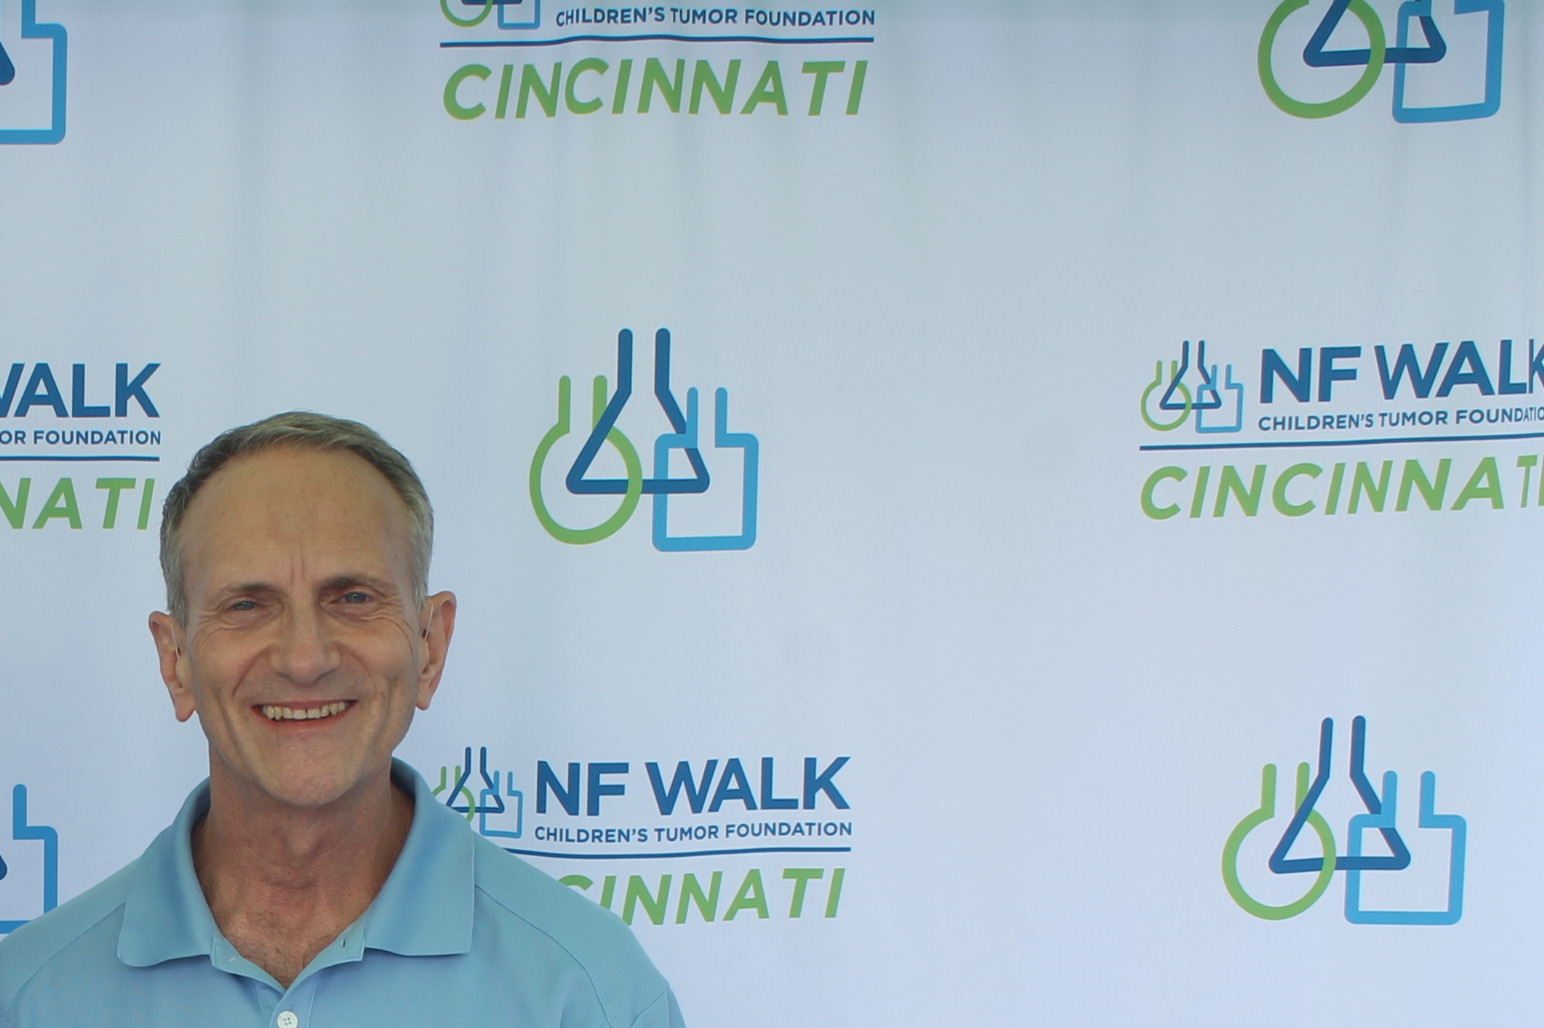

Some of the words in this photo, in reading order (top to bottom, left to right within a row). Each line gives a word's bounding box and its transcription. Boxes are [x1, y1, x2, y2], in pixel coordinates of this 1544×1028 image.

[555, 7, 665, 27] CHILDREN'S
[670, 8, 737, 25] TUMOR
[744, 9, 875, 27] FOUNDATION
[443, 57, 868, 121] CINCINNATI
[1260, 345, 1362, 404] NF
[1374, 339, 1544, 400] WALK
[1258, 413, 1374, 431] CHILDREN'S
[1379, 410, 1448, 428] TUMOR
[33, 429, 161, 446] FOUNDATION
[536, 760, 629, 816] NF
[645, 756, 852, 816] WALK
[534, 826, 648, 843] CHILDREN'S
[654, 824, 719, 842] TUMOR
[726, 822, 852, 839] FOUNDATION
